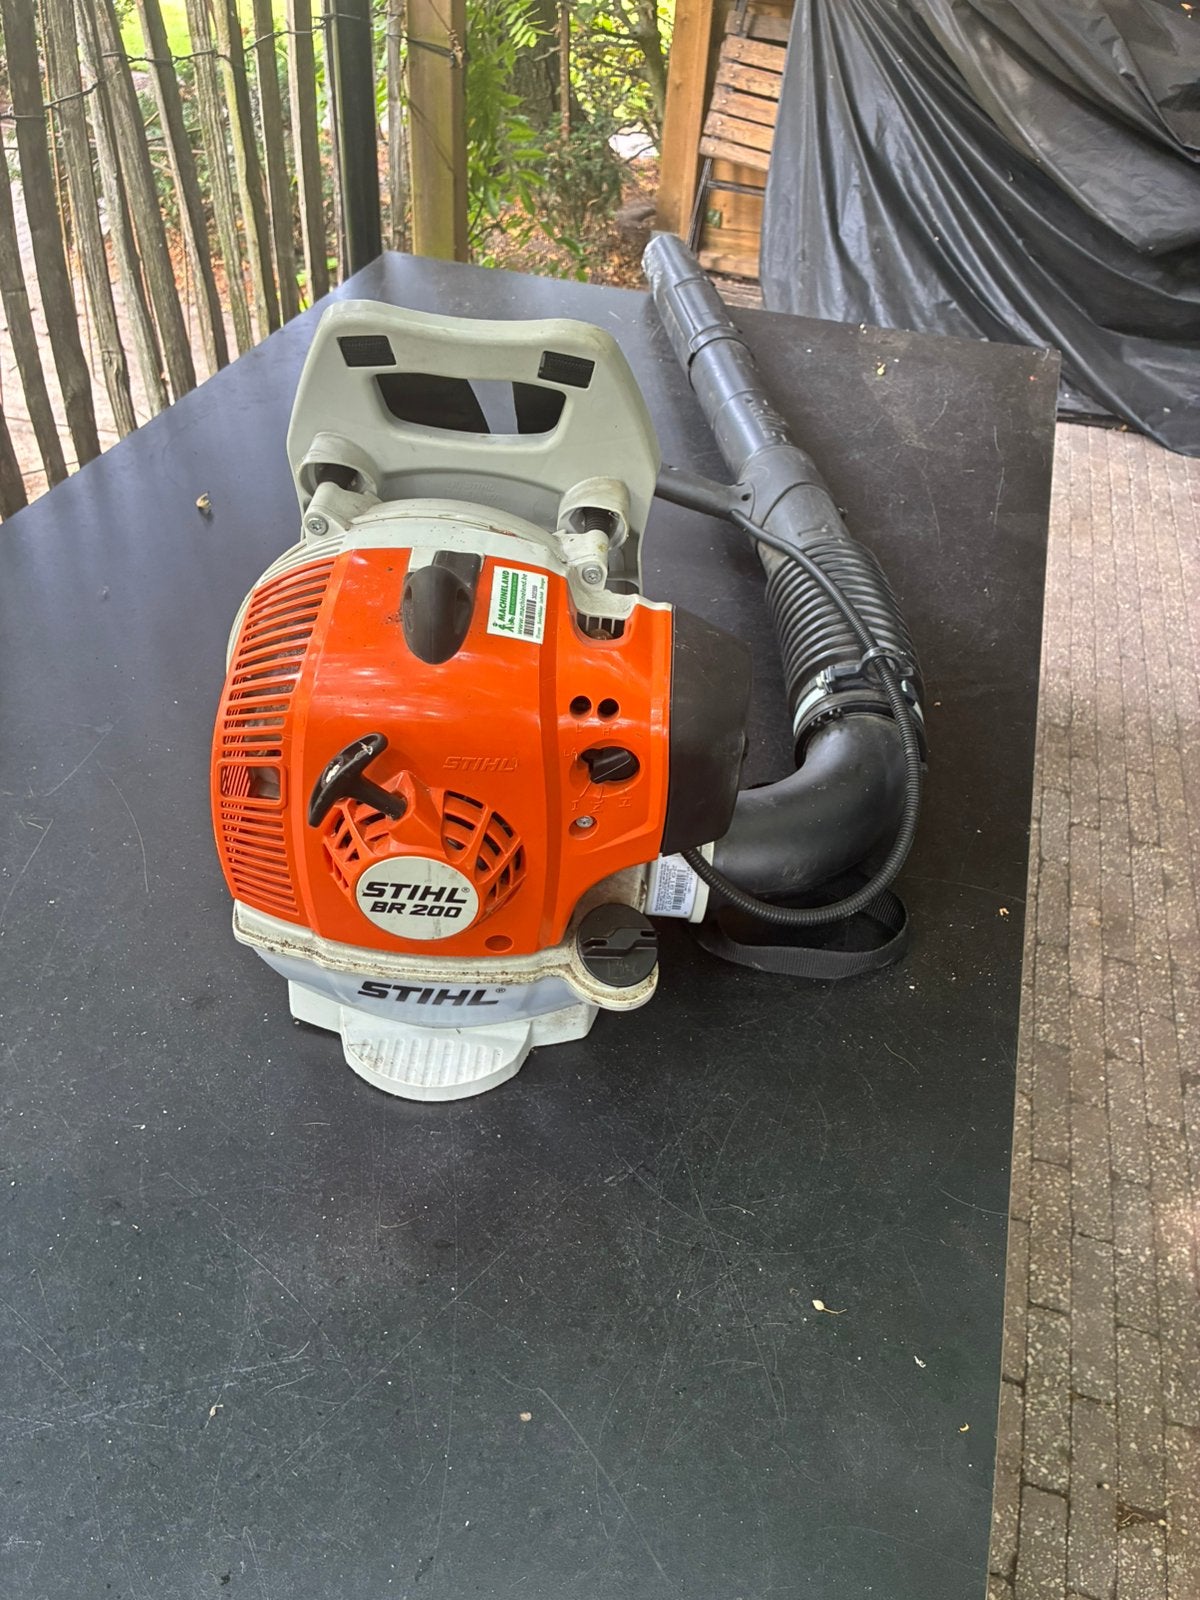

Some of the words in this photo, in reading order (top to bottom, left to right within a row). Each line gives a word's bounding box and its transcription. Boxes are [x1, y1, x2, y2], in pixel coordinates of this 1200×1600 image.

[497, 570, 510, 622] MACHINELAND
[517, 573, 528, 635] www.machineland.be
[442, 756, 515, 772] STIHL
[370, 901, 406, 915] BR
[409, 904, 462, 918] 200
